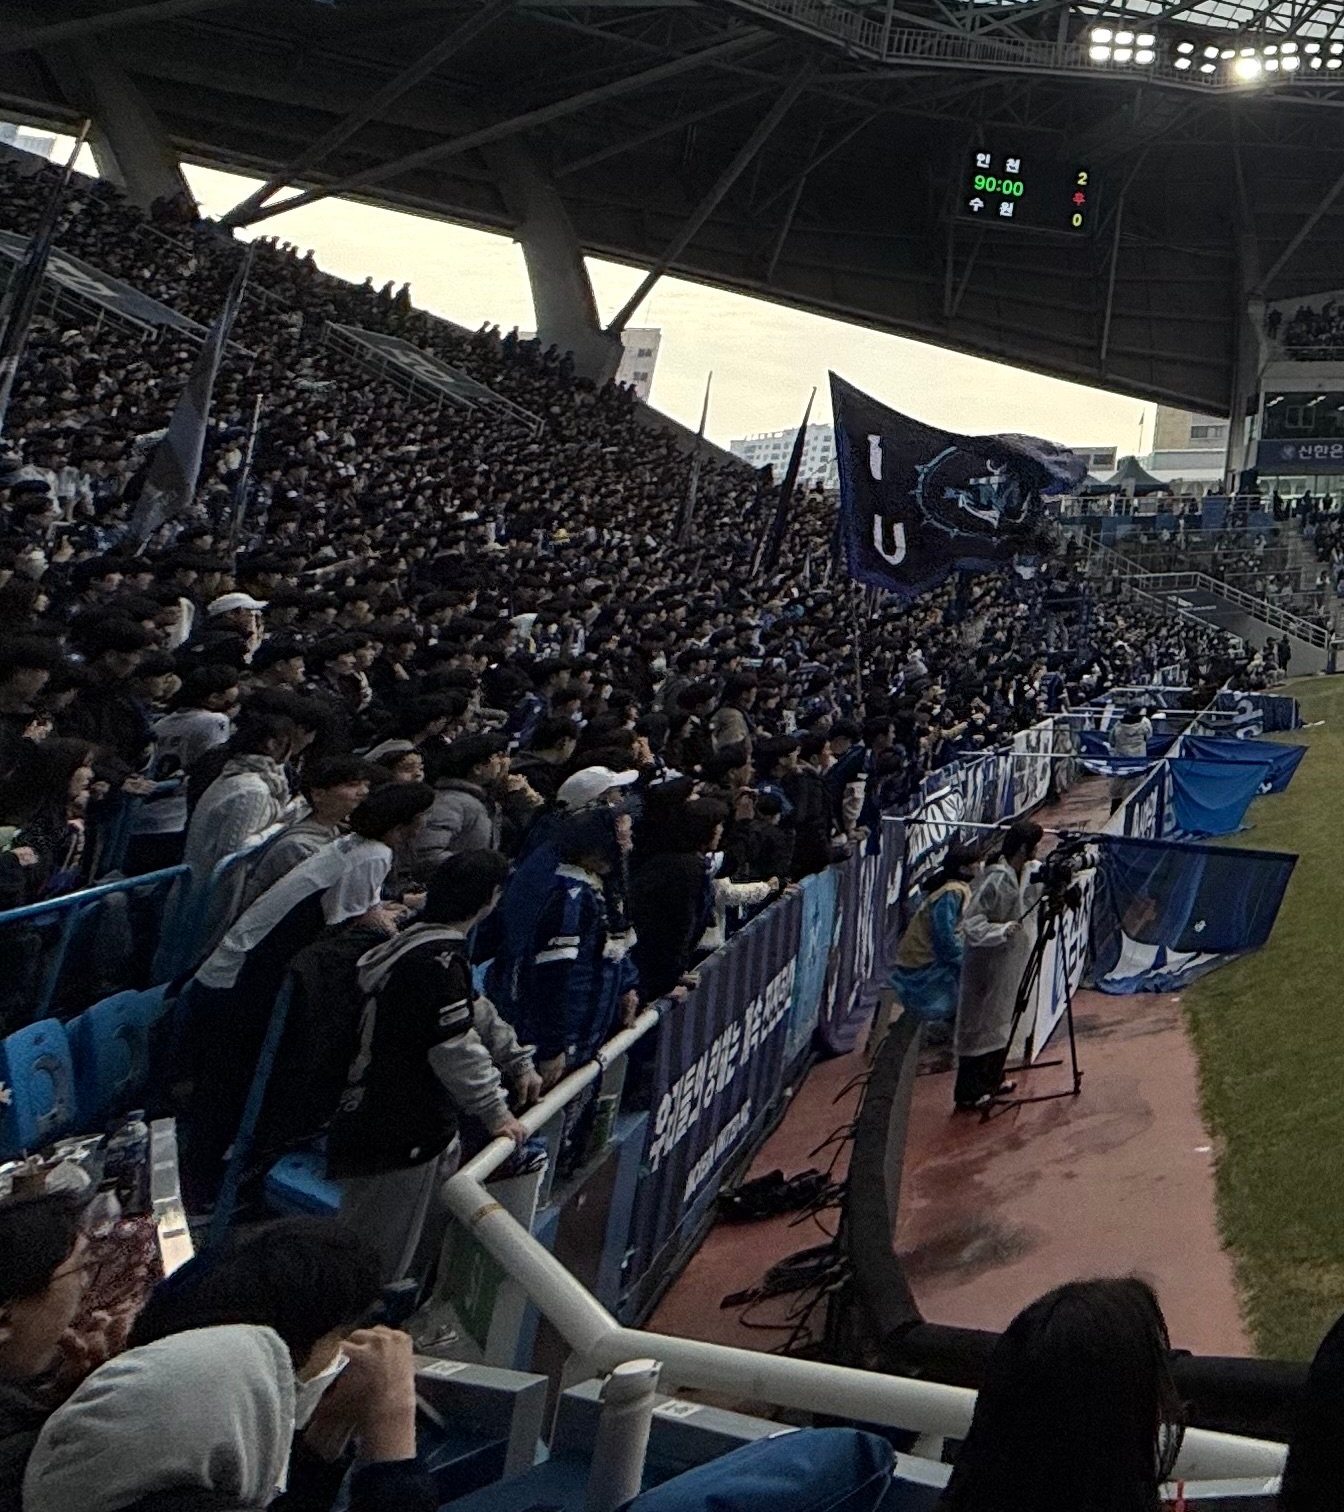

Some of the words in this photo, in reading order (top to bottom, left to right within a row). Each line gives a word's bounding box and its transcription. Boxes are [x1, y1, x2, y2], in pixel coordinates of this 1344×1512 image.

[974, 174, 1024, 196] 90:00
[1077, 171, 1088, 185] 2
[1072, 213, 1082, 226] 0
[873, 514, 906, 566] U
